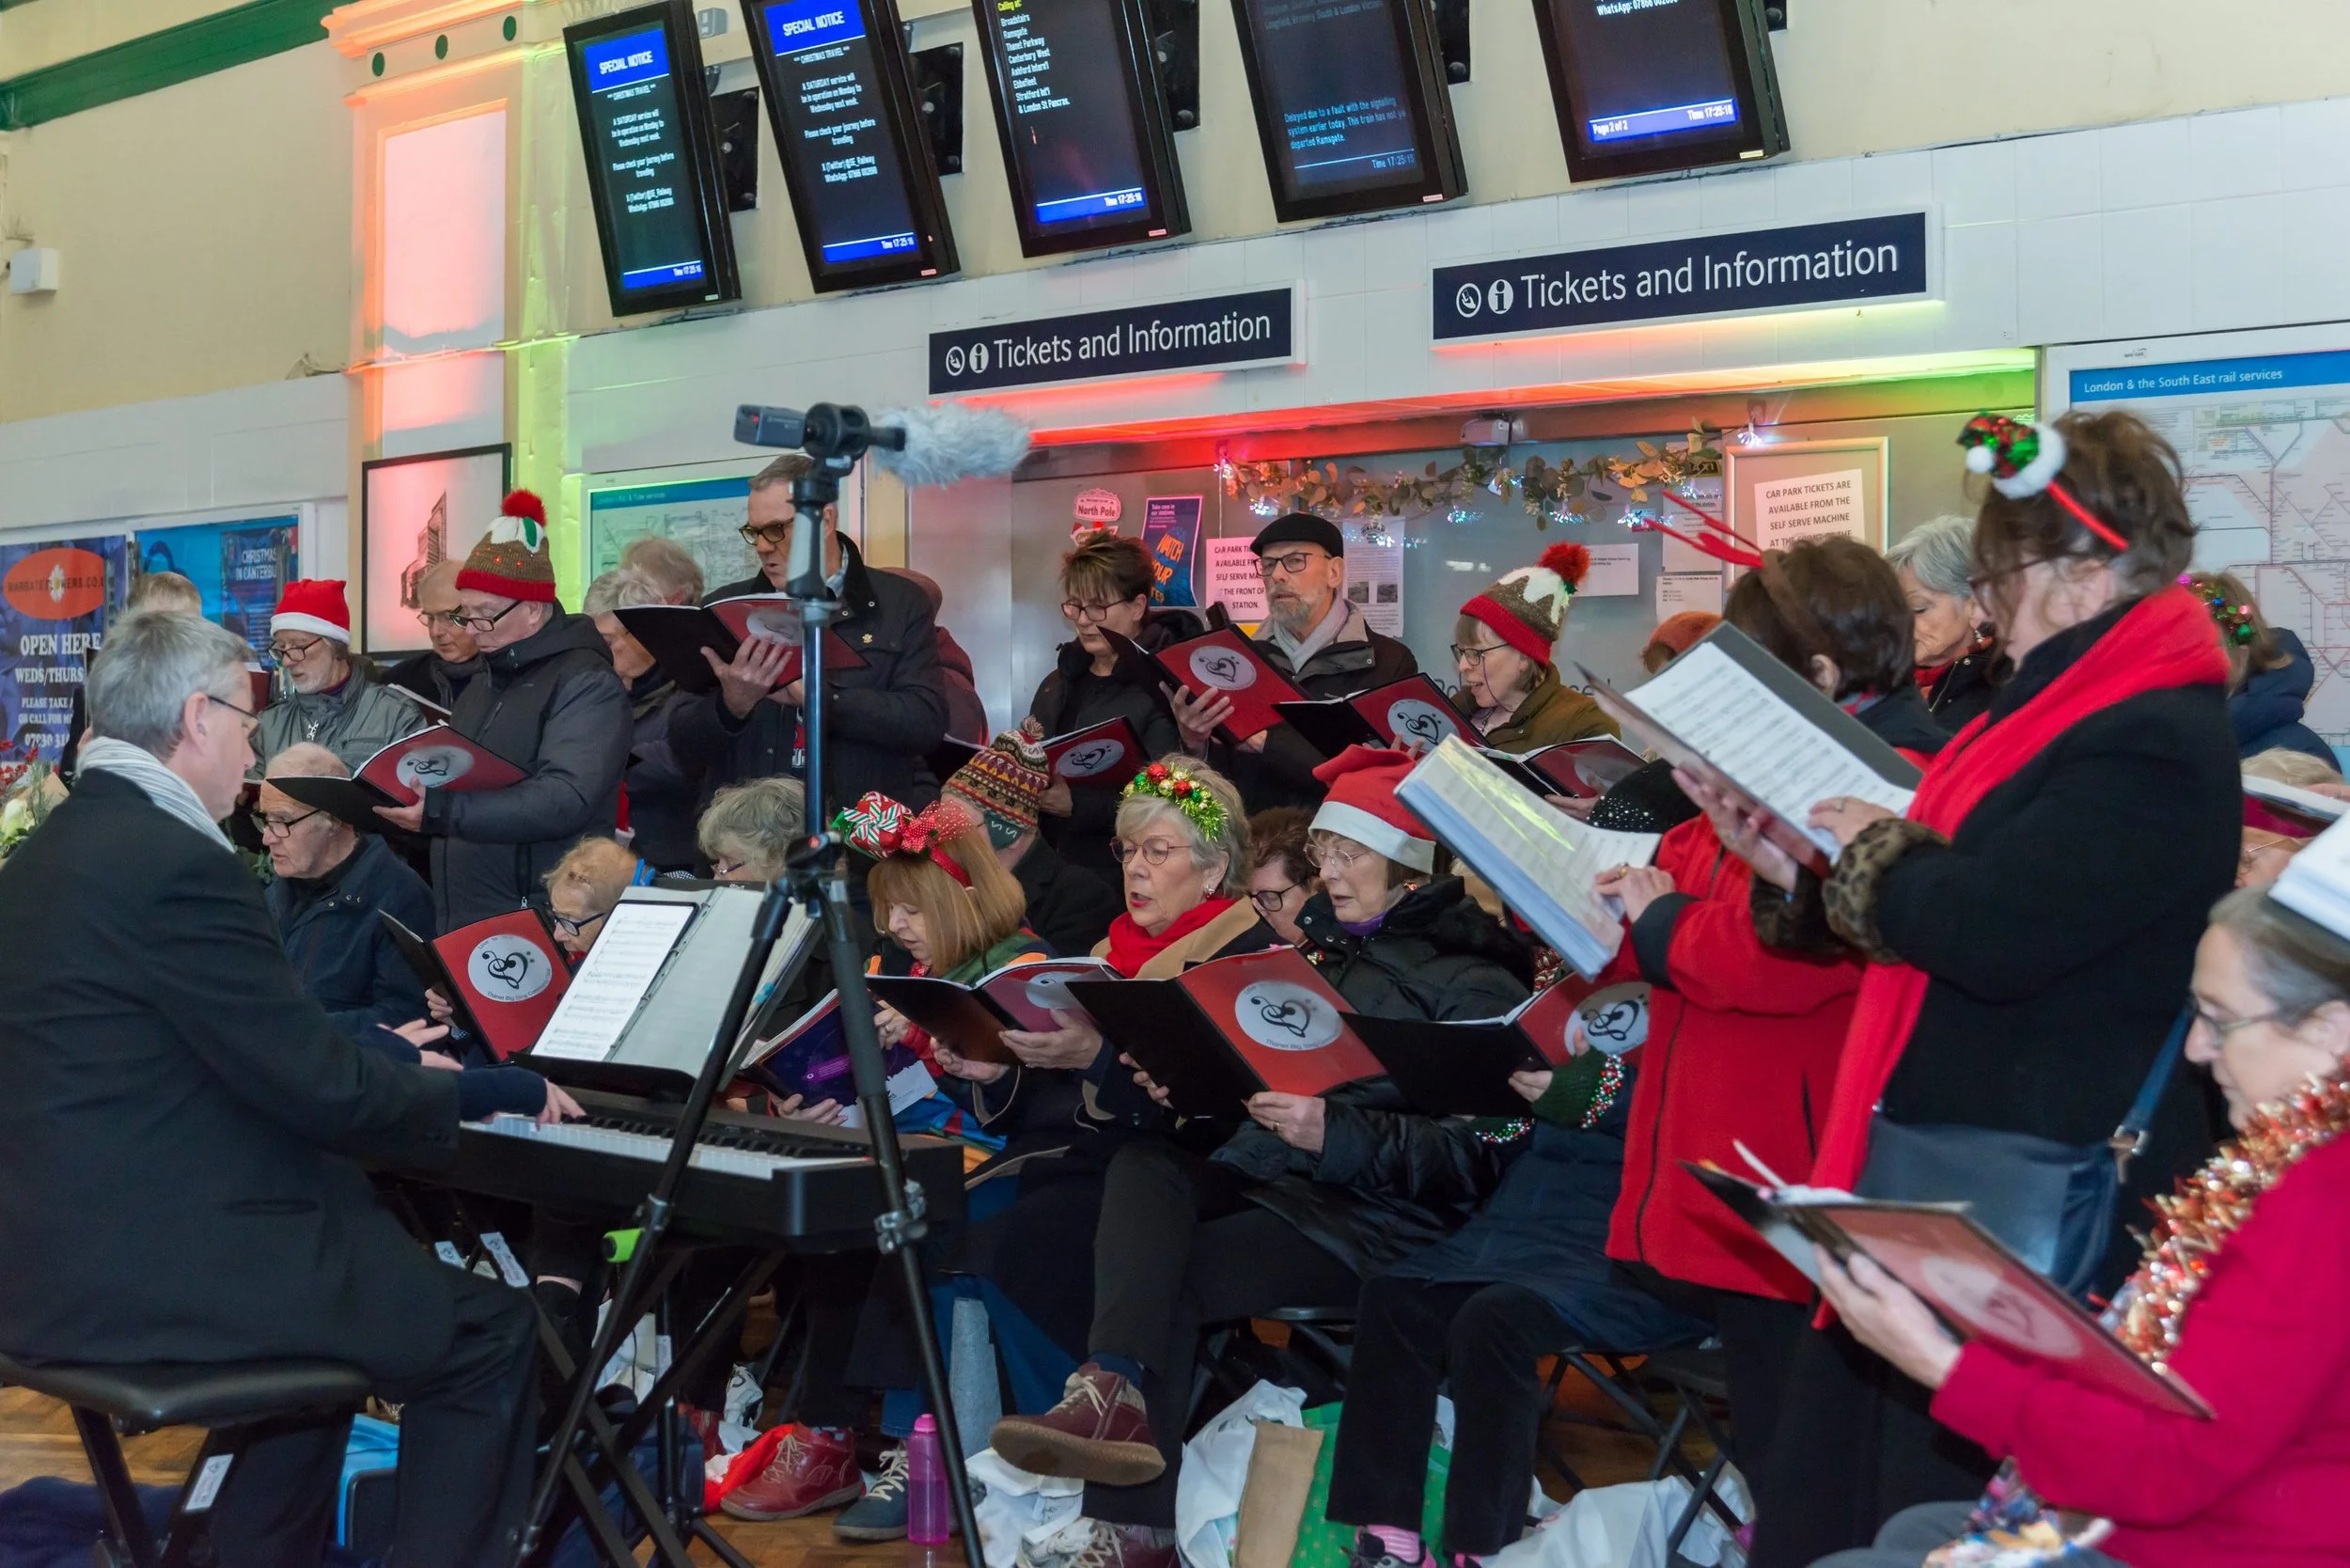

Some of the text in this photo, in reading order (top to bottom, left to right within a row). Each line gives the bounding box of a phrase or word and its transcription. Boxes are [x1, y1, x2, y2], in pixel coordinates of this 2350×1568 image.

[1596, 2, 1633, 16] WhatsApp:
[782, 10, 845, 36] SPECIAL NOTICE
[1000, 13, 1030, 26] Broadstairs
[1003, 26, 1028, 39] Ramsgate
[1006, 37, 1045, 52] Thanet Parkway
[599, 50, 653, 74] SPECIAL NOTICE
[800, 47, 844, 63] CHRISTMAS TRAVEL
[1008, 47, 1051, 64] Canterbury West
[1011, 64, 1032, 76] Ashford
[1012, 76, 1037, 89] Ebbsfleet
[1015, 88, 1041, 102] Stratford
[1023, 102, 1042, 113] London
[1041, 100, 1048, 110] St
[1284, 110, 1308, 123] Delayed
[1308, 109, 1318, 118] due
[1318, 108, 1326, 118] to
[1331, 104, 1345, 115] fault
[1345, 102, 1359, 113] with
[1359, 101, 1370, 110] the
[1687, 109, 1704, 121] Time
[1288, 110, 1398, 137] system earlier today. This train has not
[1592, 119, 1628, 136] Page 2 of 2
[1290, 132, 1346, 150] departed Ramsgate.
[1372, 159, 1386, 169] Time
[1520, 240, 1897, 308] Tickets and Information
[994, 311, 1270, 369] Tickets and Information
[2084, 368, 2283, 394] London & the South East rail services
[1766, 479, 1851, 499] CAR PARK TICKETS ARE
[1077, 504, 1116, 517] North Pole
[1768, 496, 1850, 514] AVAILABLE FROM THE
[1770, 512, 1850, 530] SELF SERVE MACHINE
[1156, 533, 1184, 563] WATCH
[1770, 538, 1779, 548] AT
[1215, 558, 1246, 567] AVAILABLE
[235, 567, 242, 581] IN
[1216, 572, 1228, 581] SELF
[1236, 587, 1256, 595] FRONT
[1257, 587, 1264, 595] OF
[1231, 601, 1260, 609] STATION.
[20, 632, 102, 656] OPEN HERE
[14, 666, 85, 686] WEDS/THURS
[22, 698, 48, 708] PLEASE
[49, 698, 69, 708] TAKE
[18, 713, 28, 724] OR
[29, 713, 47, 724] CALL
[48, 713, 62, 724] FOR
